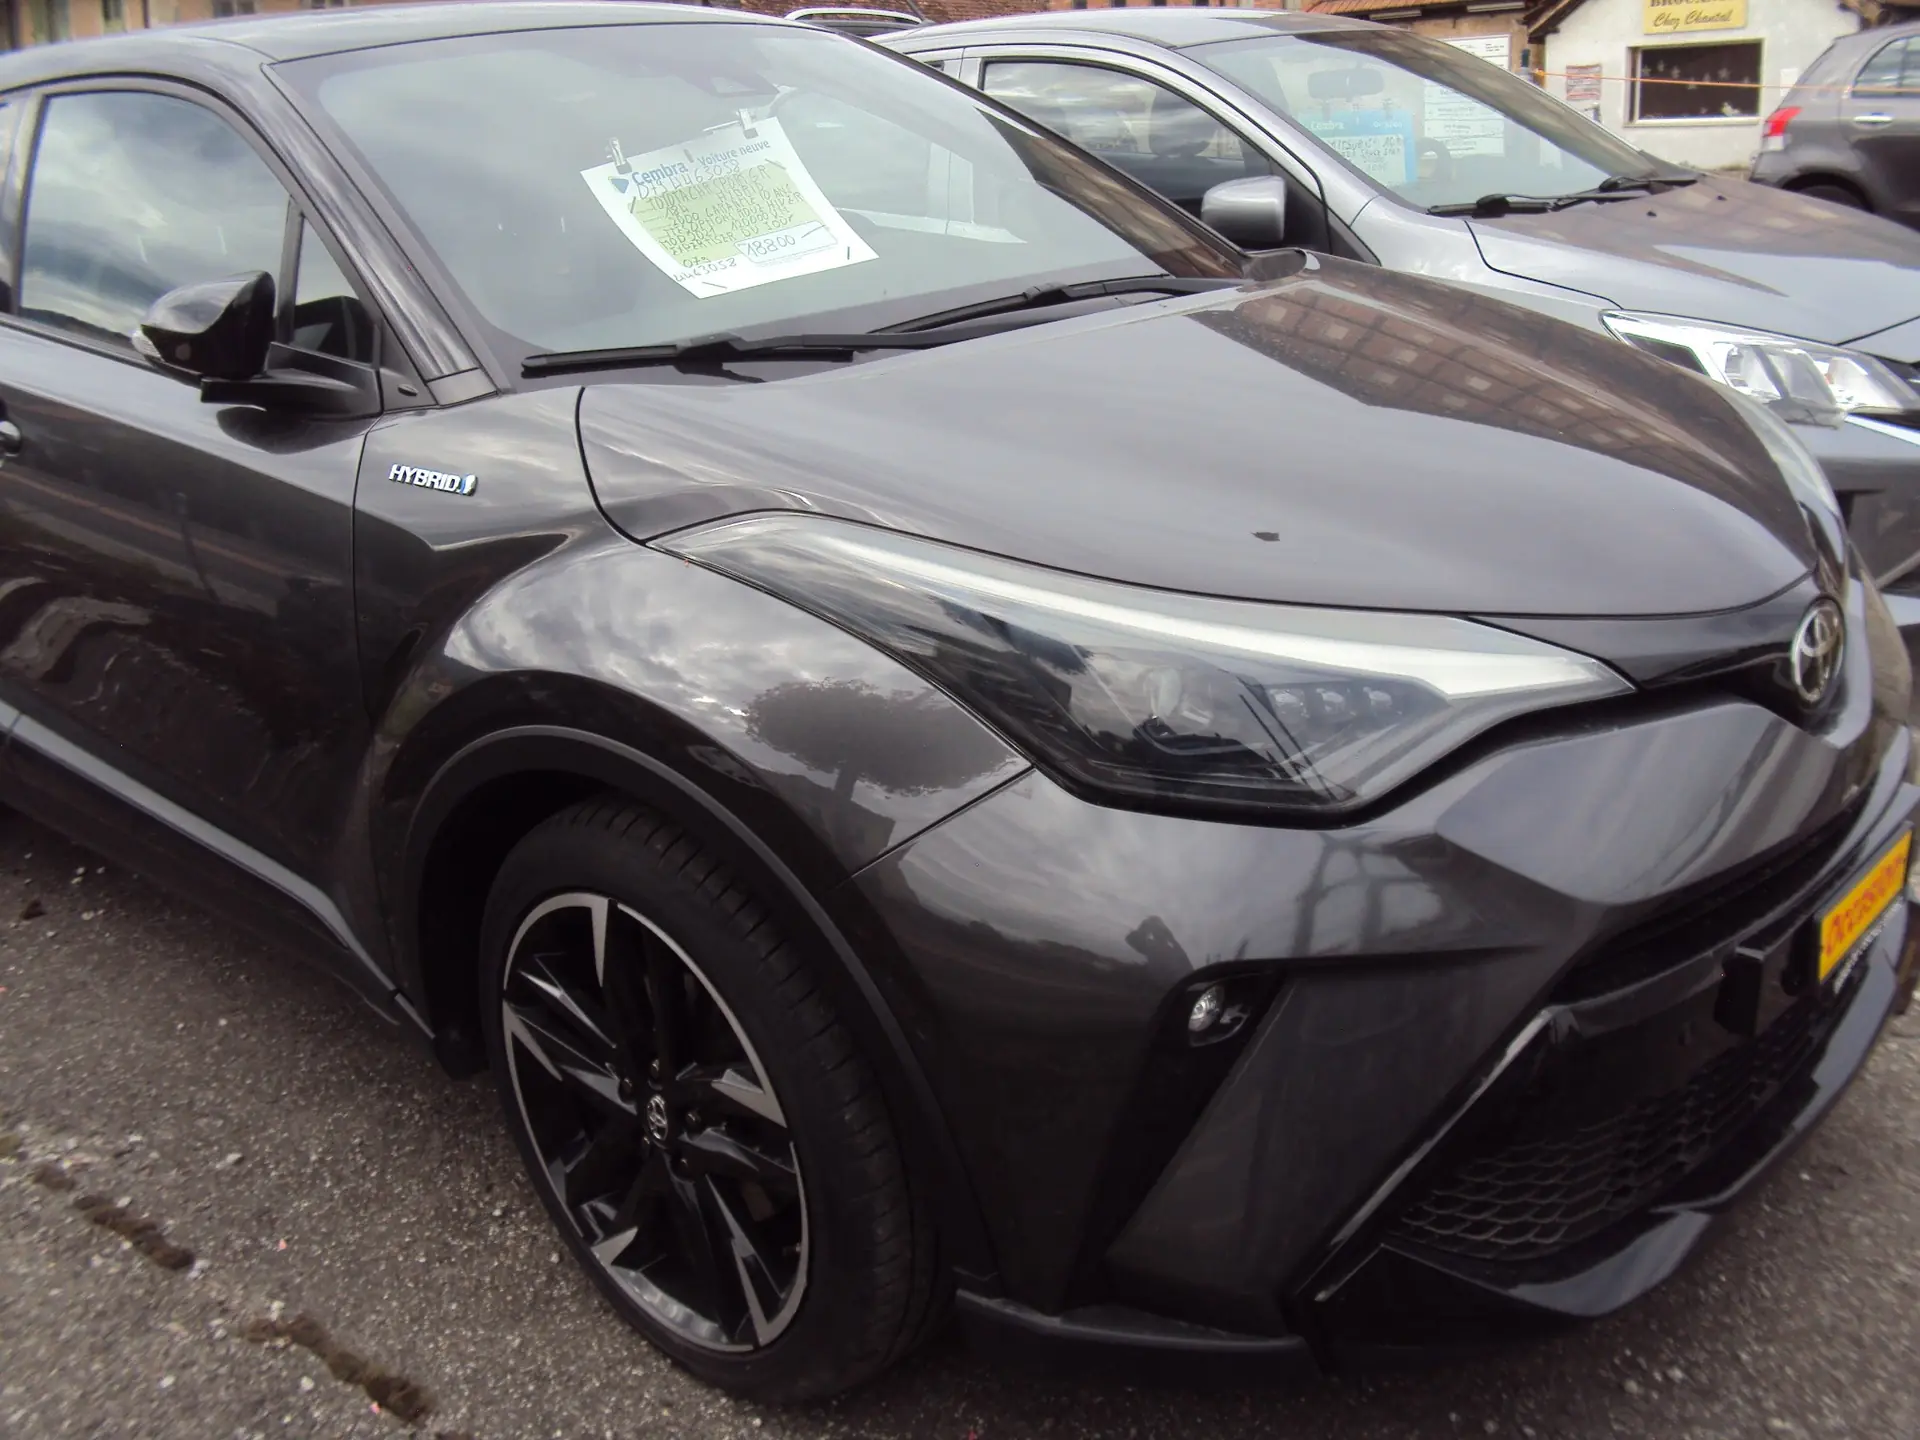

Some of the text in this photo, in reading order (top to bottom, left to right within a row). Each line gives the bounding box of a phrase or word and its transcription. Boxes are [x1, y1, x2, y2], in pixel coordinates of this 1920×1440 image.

[1653, 12, 1681, 30] Chez
[697, 140, 771, 166] Voiture neuve
[632, 162, 689, 185] Cembra
[388, 463, 462, 494] HYBRID
